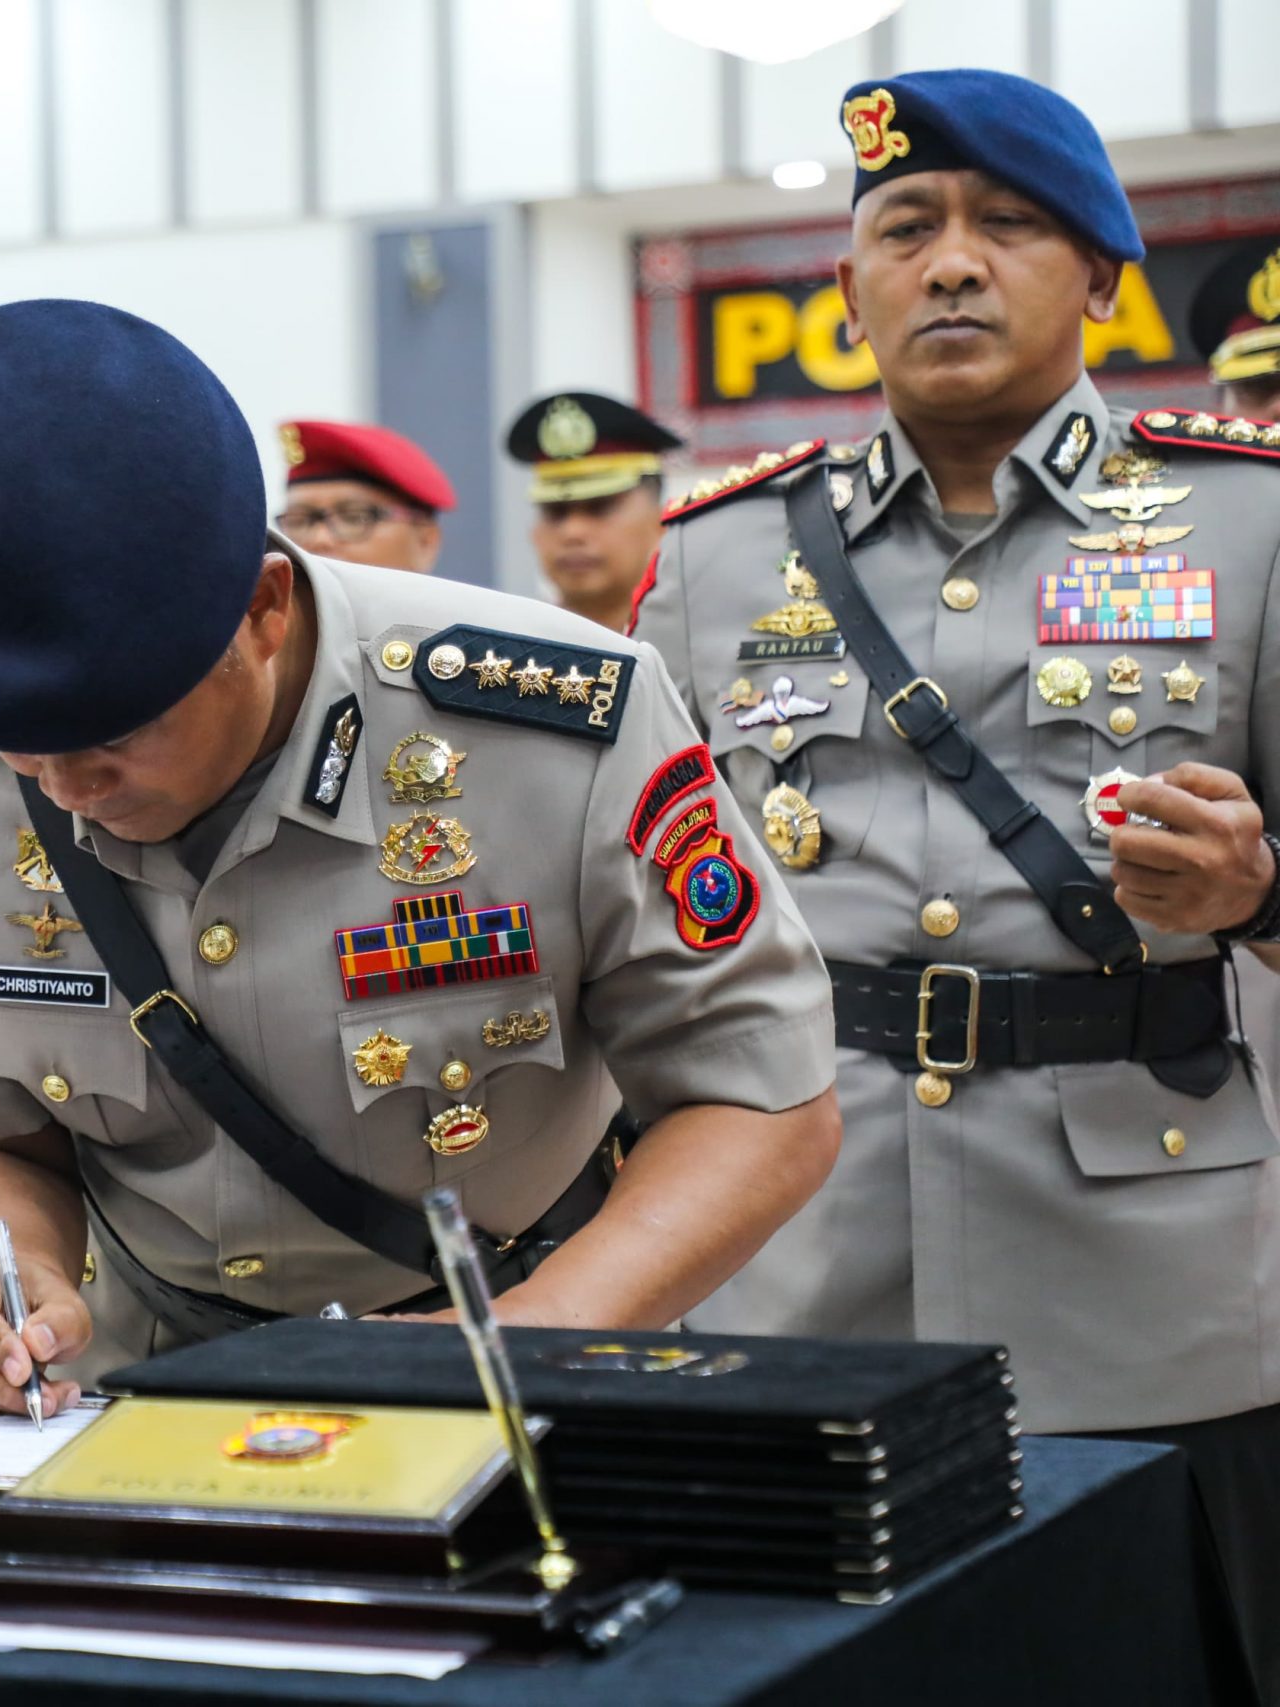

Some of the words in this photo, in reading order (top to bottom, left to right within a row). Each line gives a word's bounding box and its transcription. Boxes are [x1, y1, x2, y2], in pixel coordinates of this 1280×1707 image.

[713, 260, 1176, 398] POA
[755, 640, 824, 657] RANTAU
[588, 659, 622, 728] POLISI
[659, 820, 689, 860] SUMATERA
[687, 806, 711, 827] UTARA
